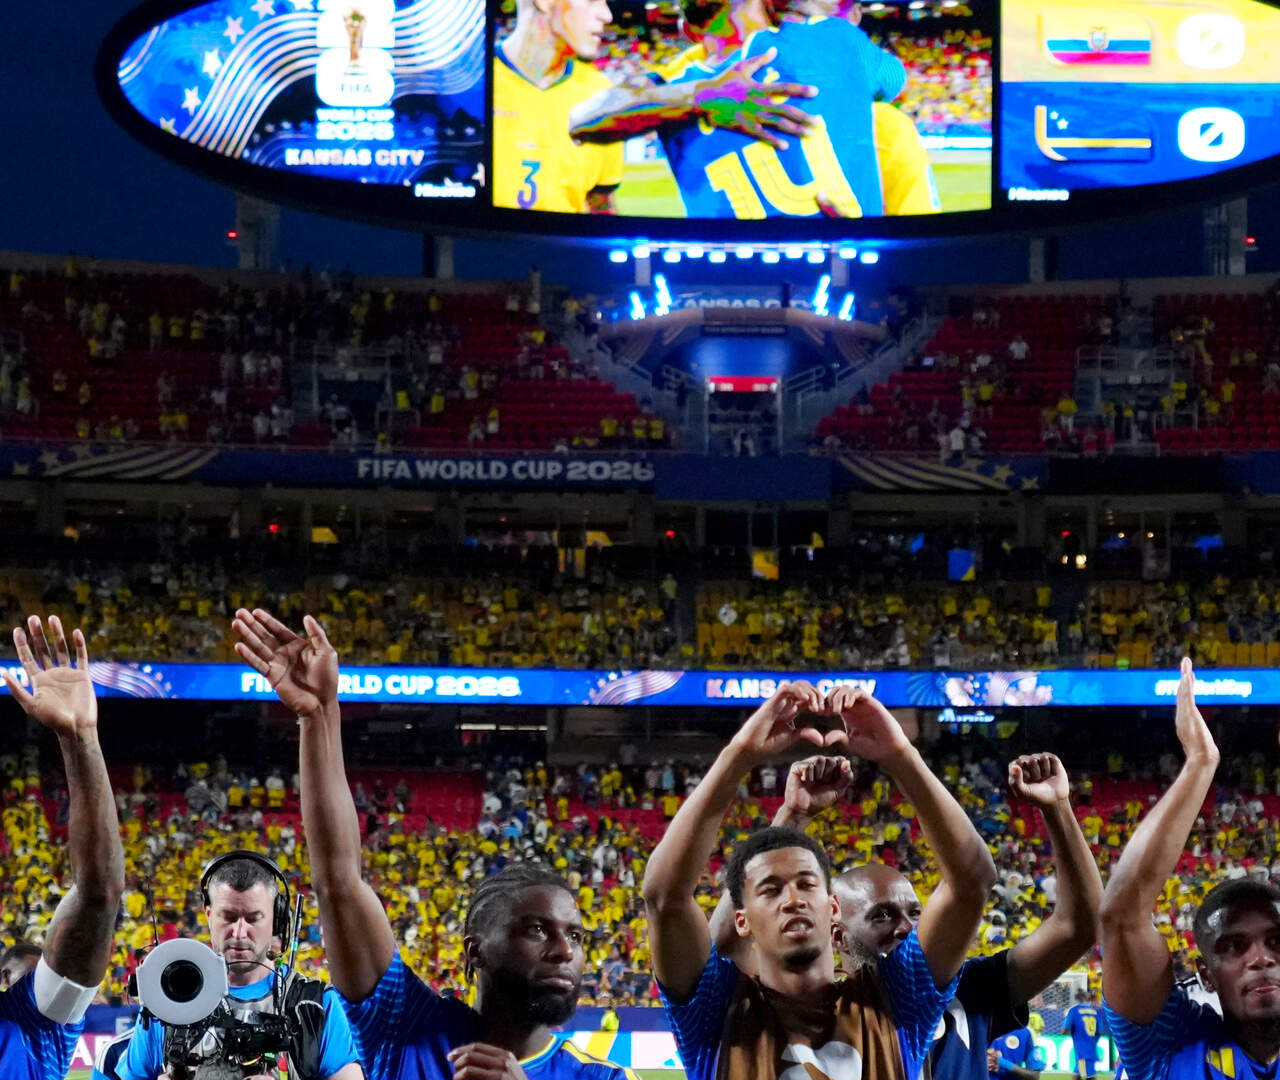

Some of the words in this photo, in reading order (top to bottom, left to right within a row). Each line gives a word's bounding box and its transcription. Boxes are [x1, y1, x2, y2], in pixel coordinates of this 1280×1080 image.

[284, 148, 372, 166] KANSAS
[374, 148, 425, 166] CITY
[517, 160, 541, 209] 3
[357, 459, 412, 479] FIFA
[416, 459, 508, 480] WORLD
[512, 460, 563, 480] CUP
[566, 460, 656, 481] 2026
[336, 674, 382, 695] RLD
[385, 674, 433, 694] CUP
[436, 675, 521, 697] 2026
